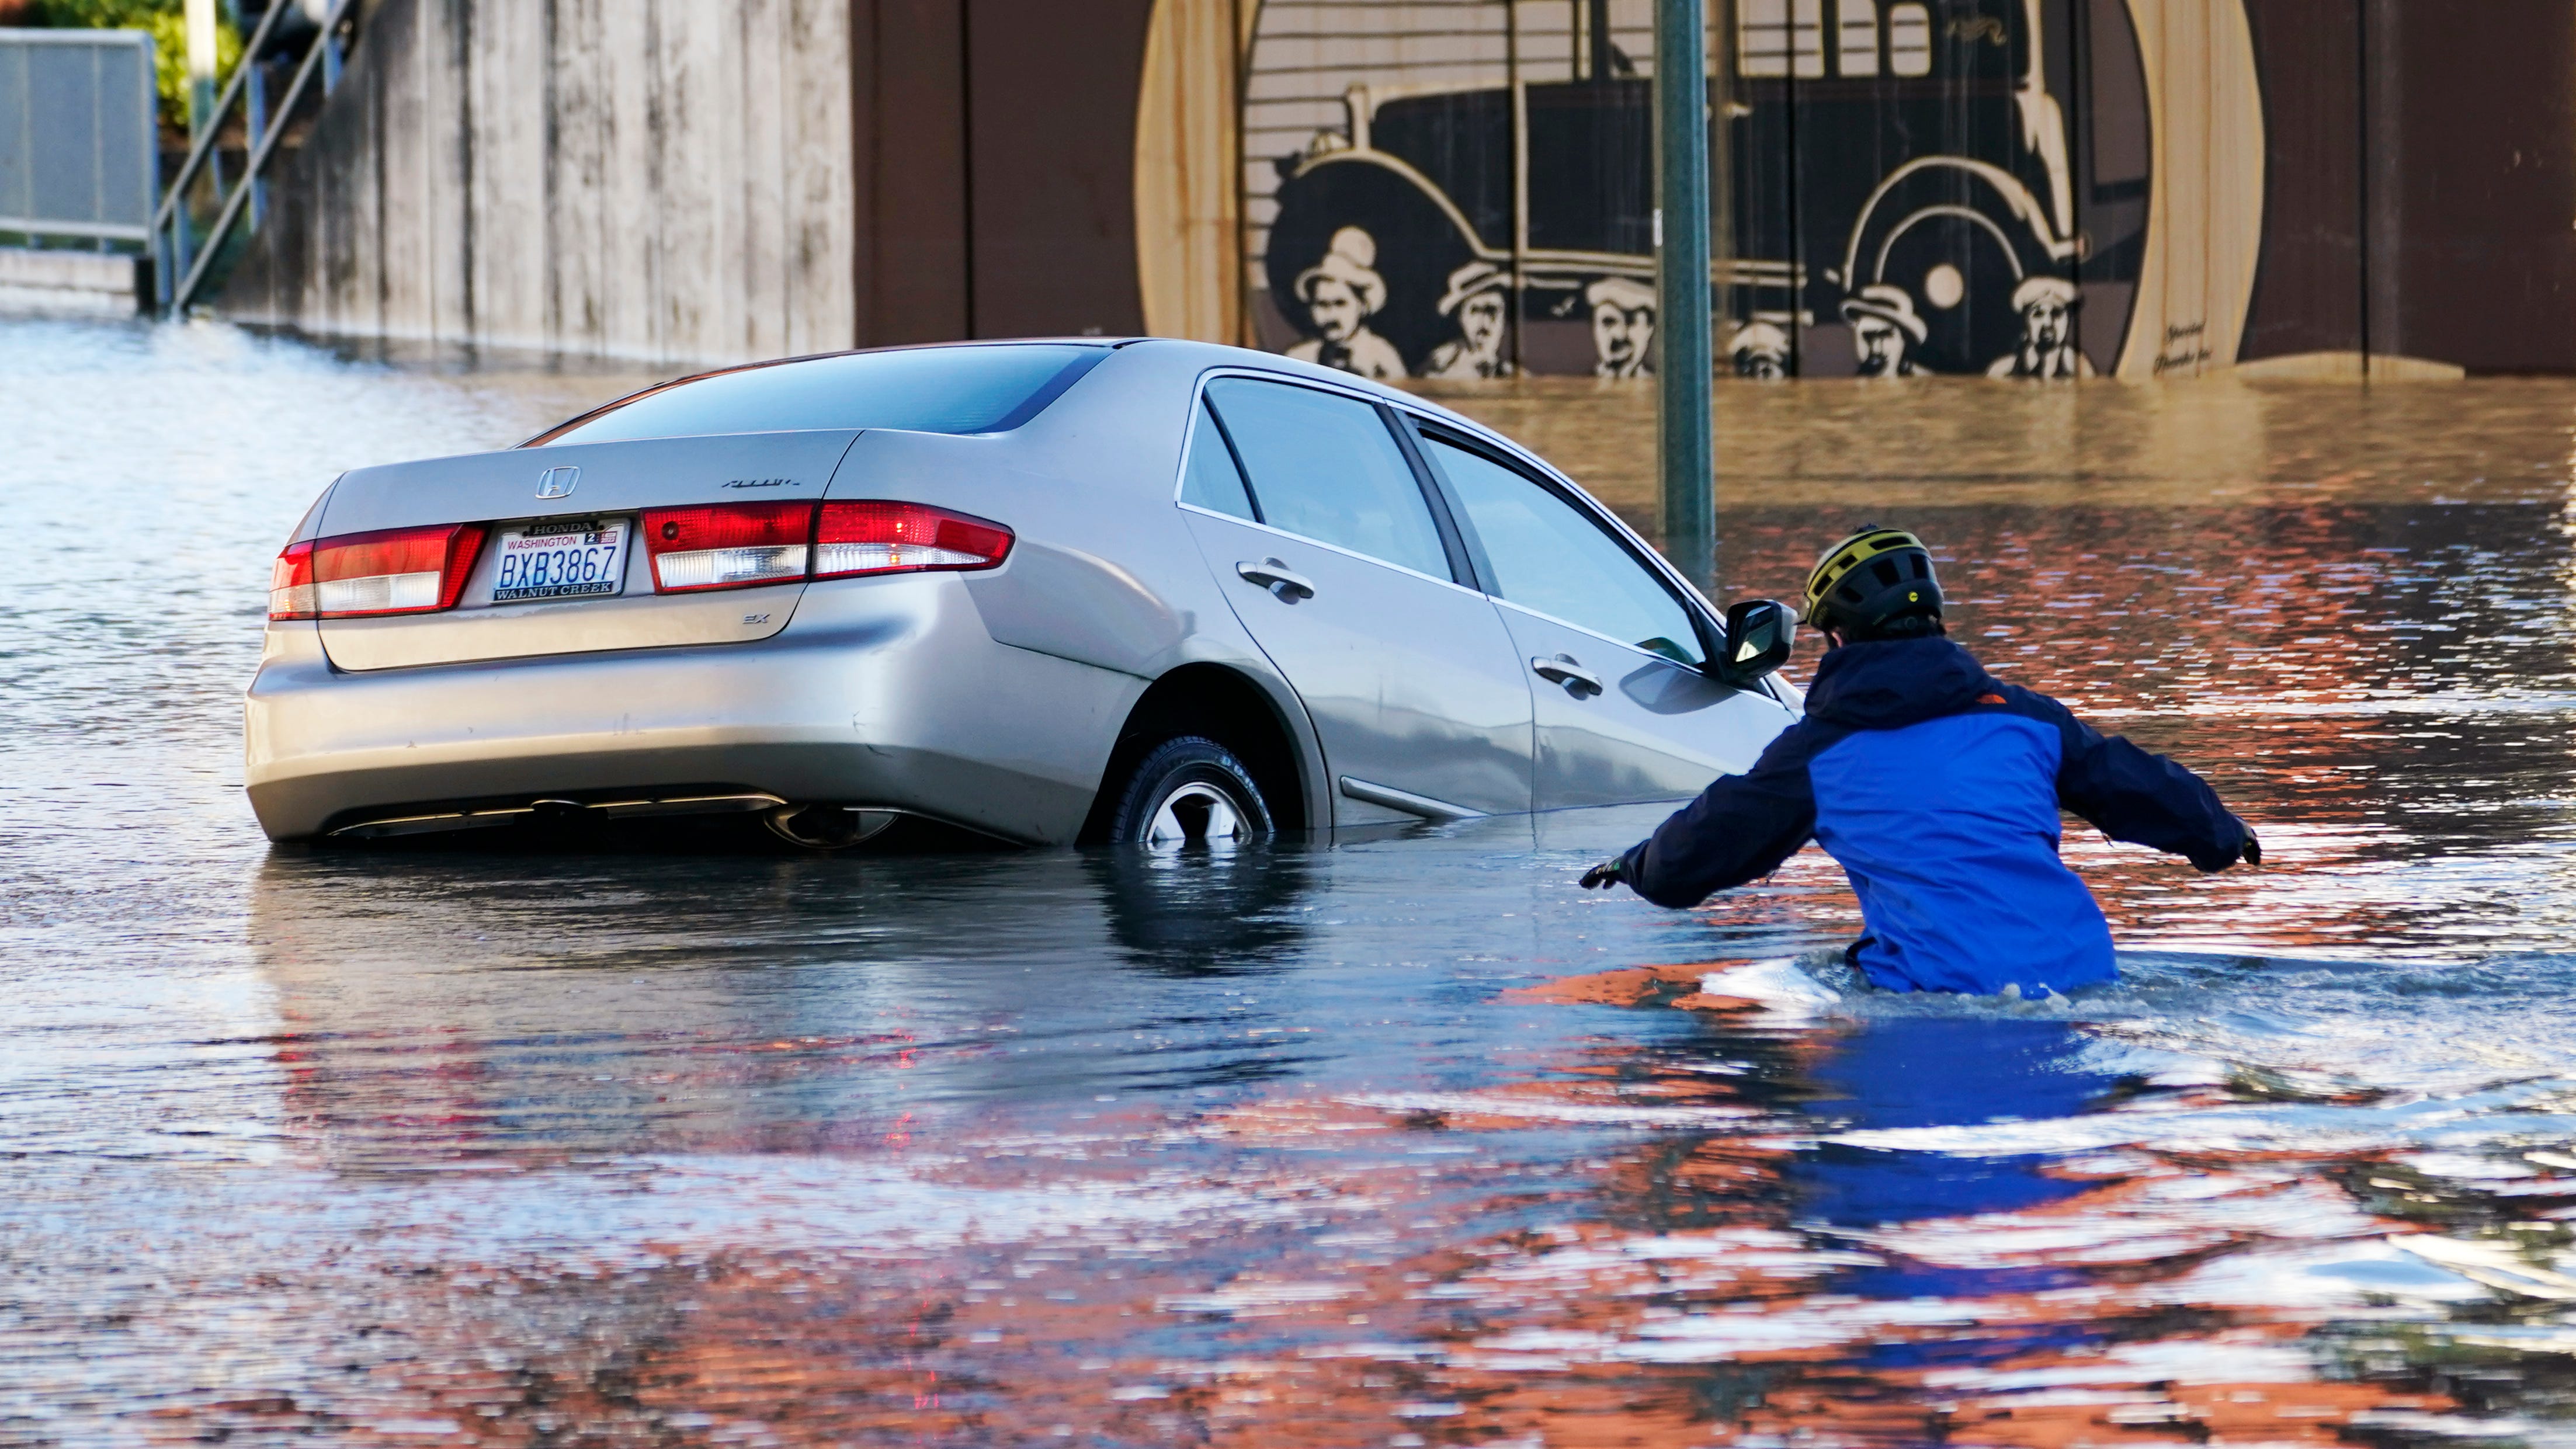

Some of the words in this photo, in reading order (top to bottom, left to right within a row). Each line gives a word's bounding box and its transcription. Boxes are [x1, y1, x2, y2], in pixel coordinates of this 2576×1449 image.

[533, 522, 593, 535] HONDA
[508, 536, 577, 550] WASHINGTON
[587, 533, 595, 543] 2
[499, 546, 616, 588] BXB3867
[496, 586, 557, 600] WALNUT
[561, 582, 612, 596] CREEK
[742, 611, 770, 624] EX
